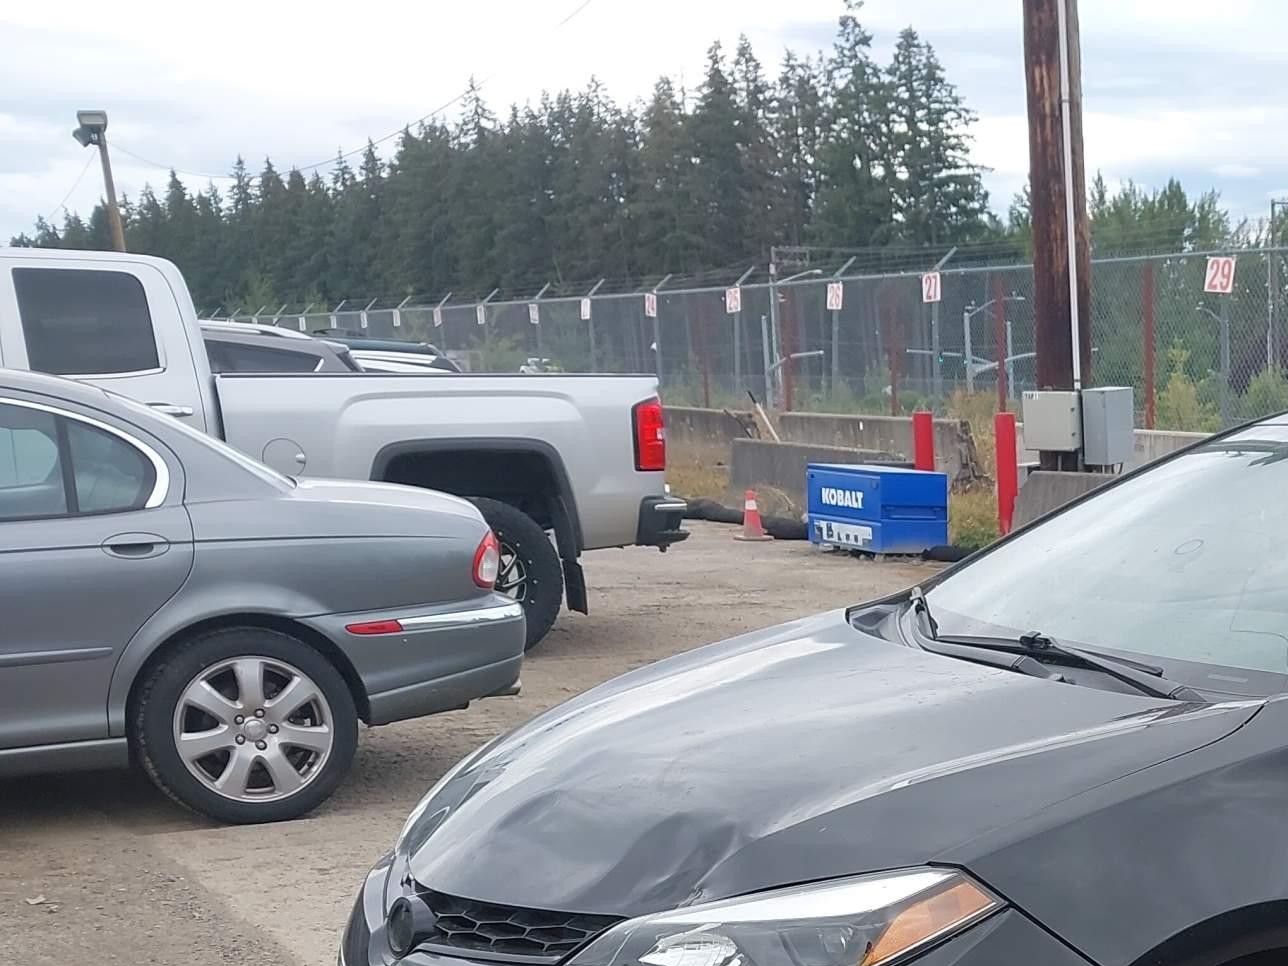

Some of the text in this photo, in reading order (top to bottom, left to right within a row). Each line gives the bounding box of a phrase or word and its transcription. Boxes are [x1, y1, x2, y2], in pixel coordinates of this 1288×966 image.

[922, 275, 938, 301] 27
[1207, 259, 1232, 291] 29
[821, 487, 864, 509] KOBALT
